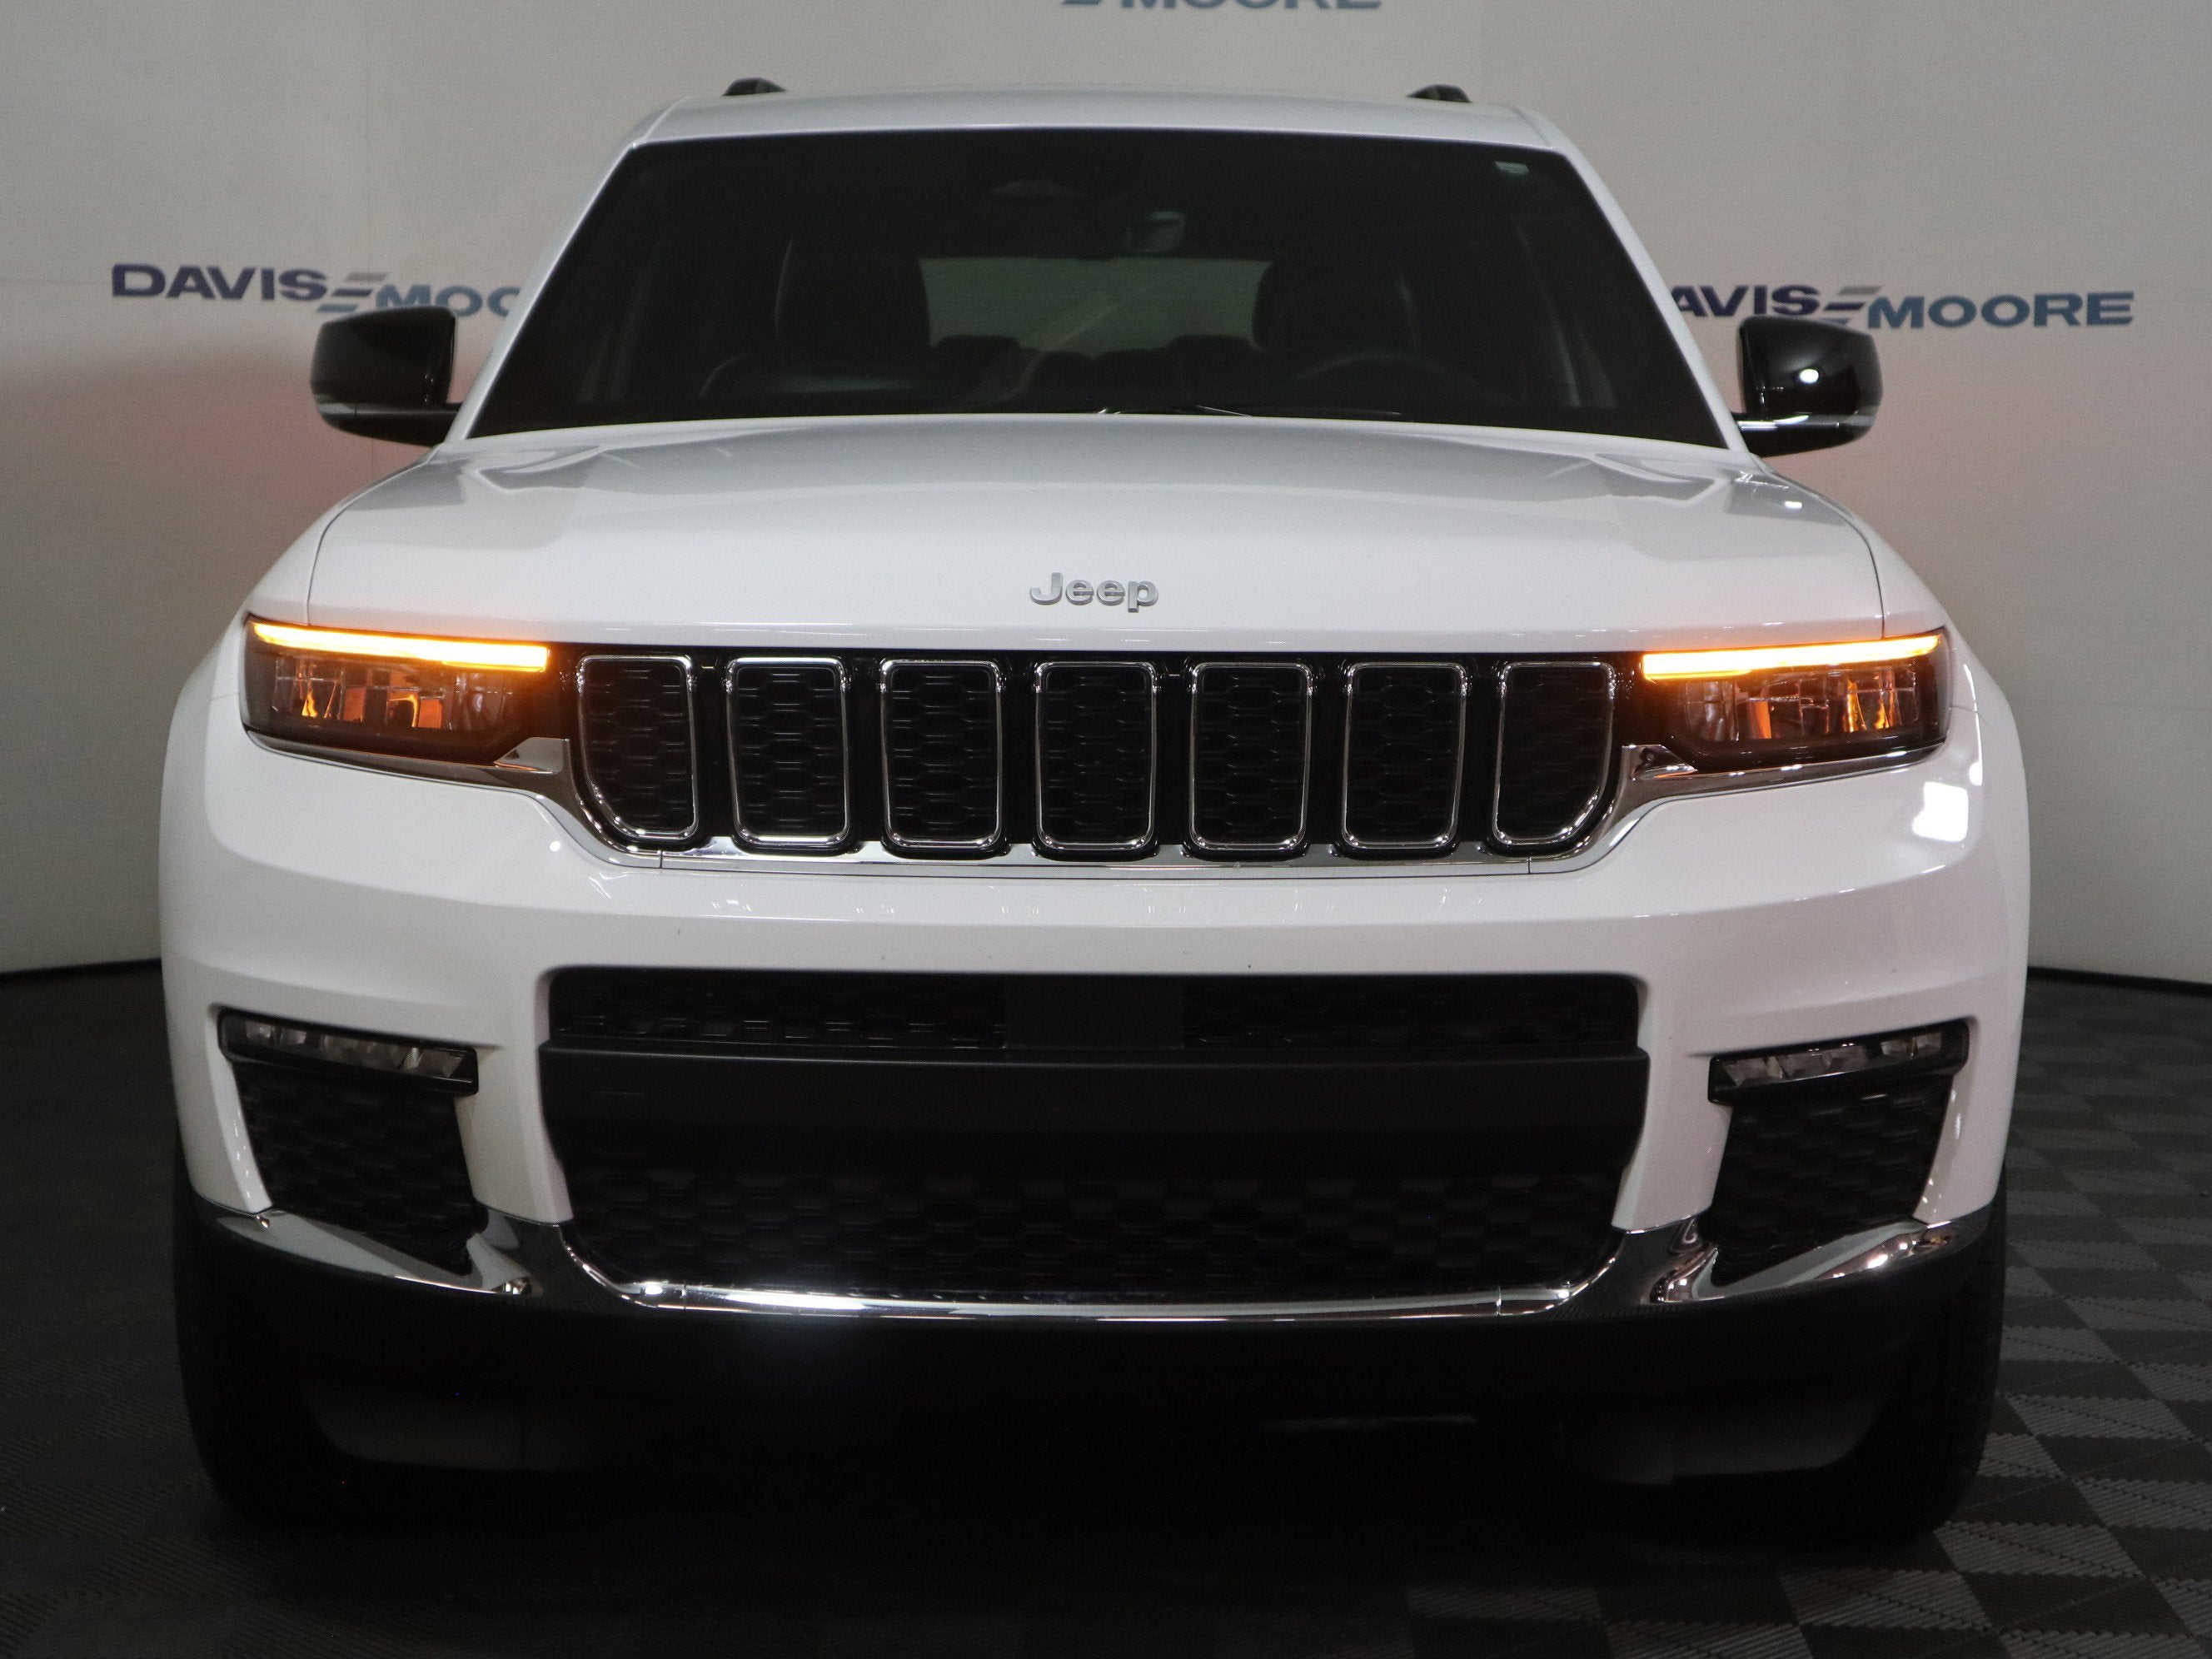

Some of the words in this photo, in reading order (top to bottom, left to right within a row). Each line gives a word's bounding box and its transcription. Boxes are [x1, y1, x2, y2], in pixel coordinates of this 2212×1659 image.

[112, 263, 328, 301] DAVIS
[1671, 284, 1821, 317] AVIS
[1866, 291, 2135, 329] MOORE
[1030, 571, 1159, 613] Jeep
